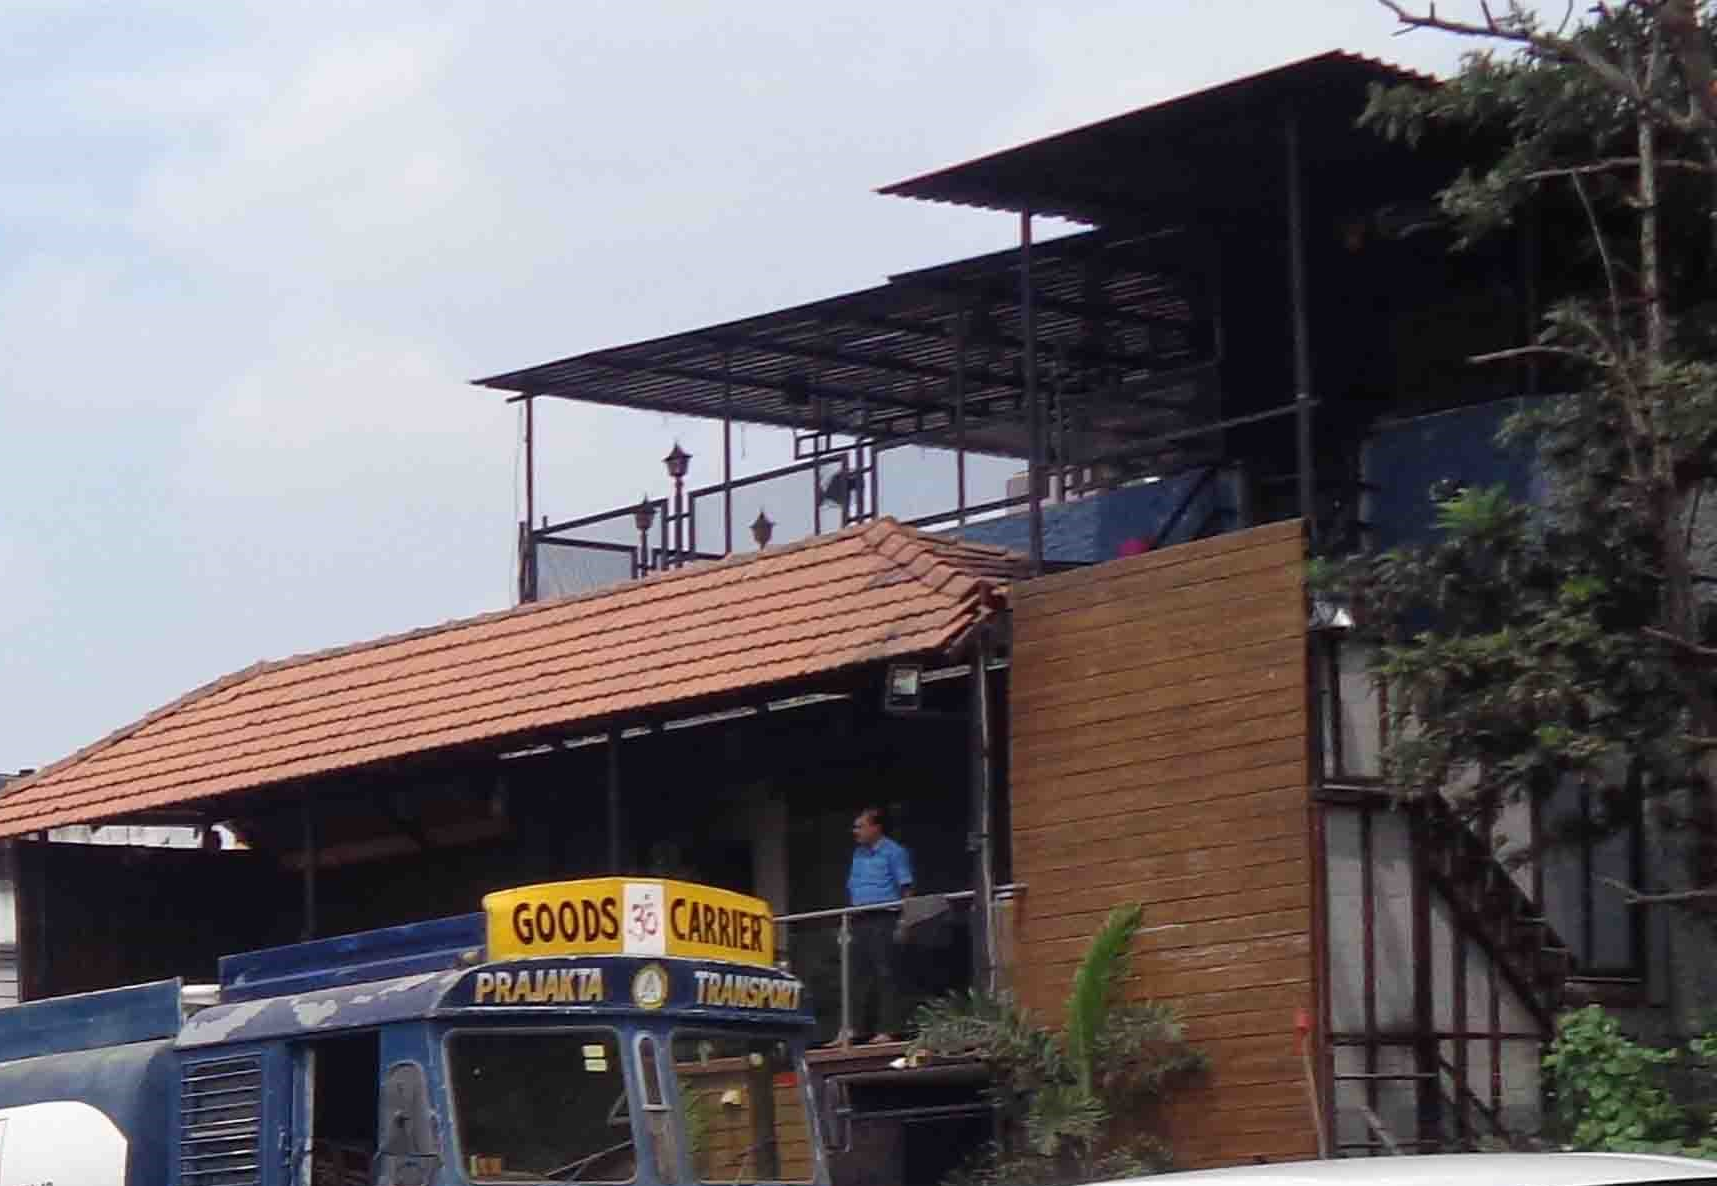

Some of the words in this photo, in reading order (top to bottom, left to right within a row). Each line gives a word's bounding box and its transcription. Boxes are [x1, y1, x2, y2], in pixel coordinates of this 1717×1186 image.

[512, 897, 620, 946] GOODS
[669, 897, 765, 954] CARRIER
[475, 967, 606, 1004] PRAJAKTA
[694, 969, 804, 1010] TRANSPORT
